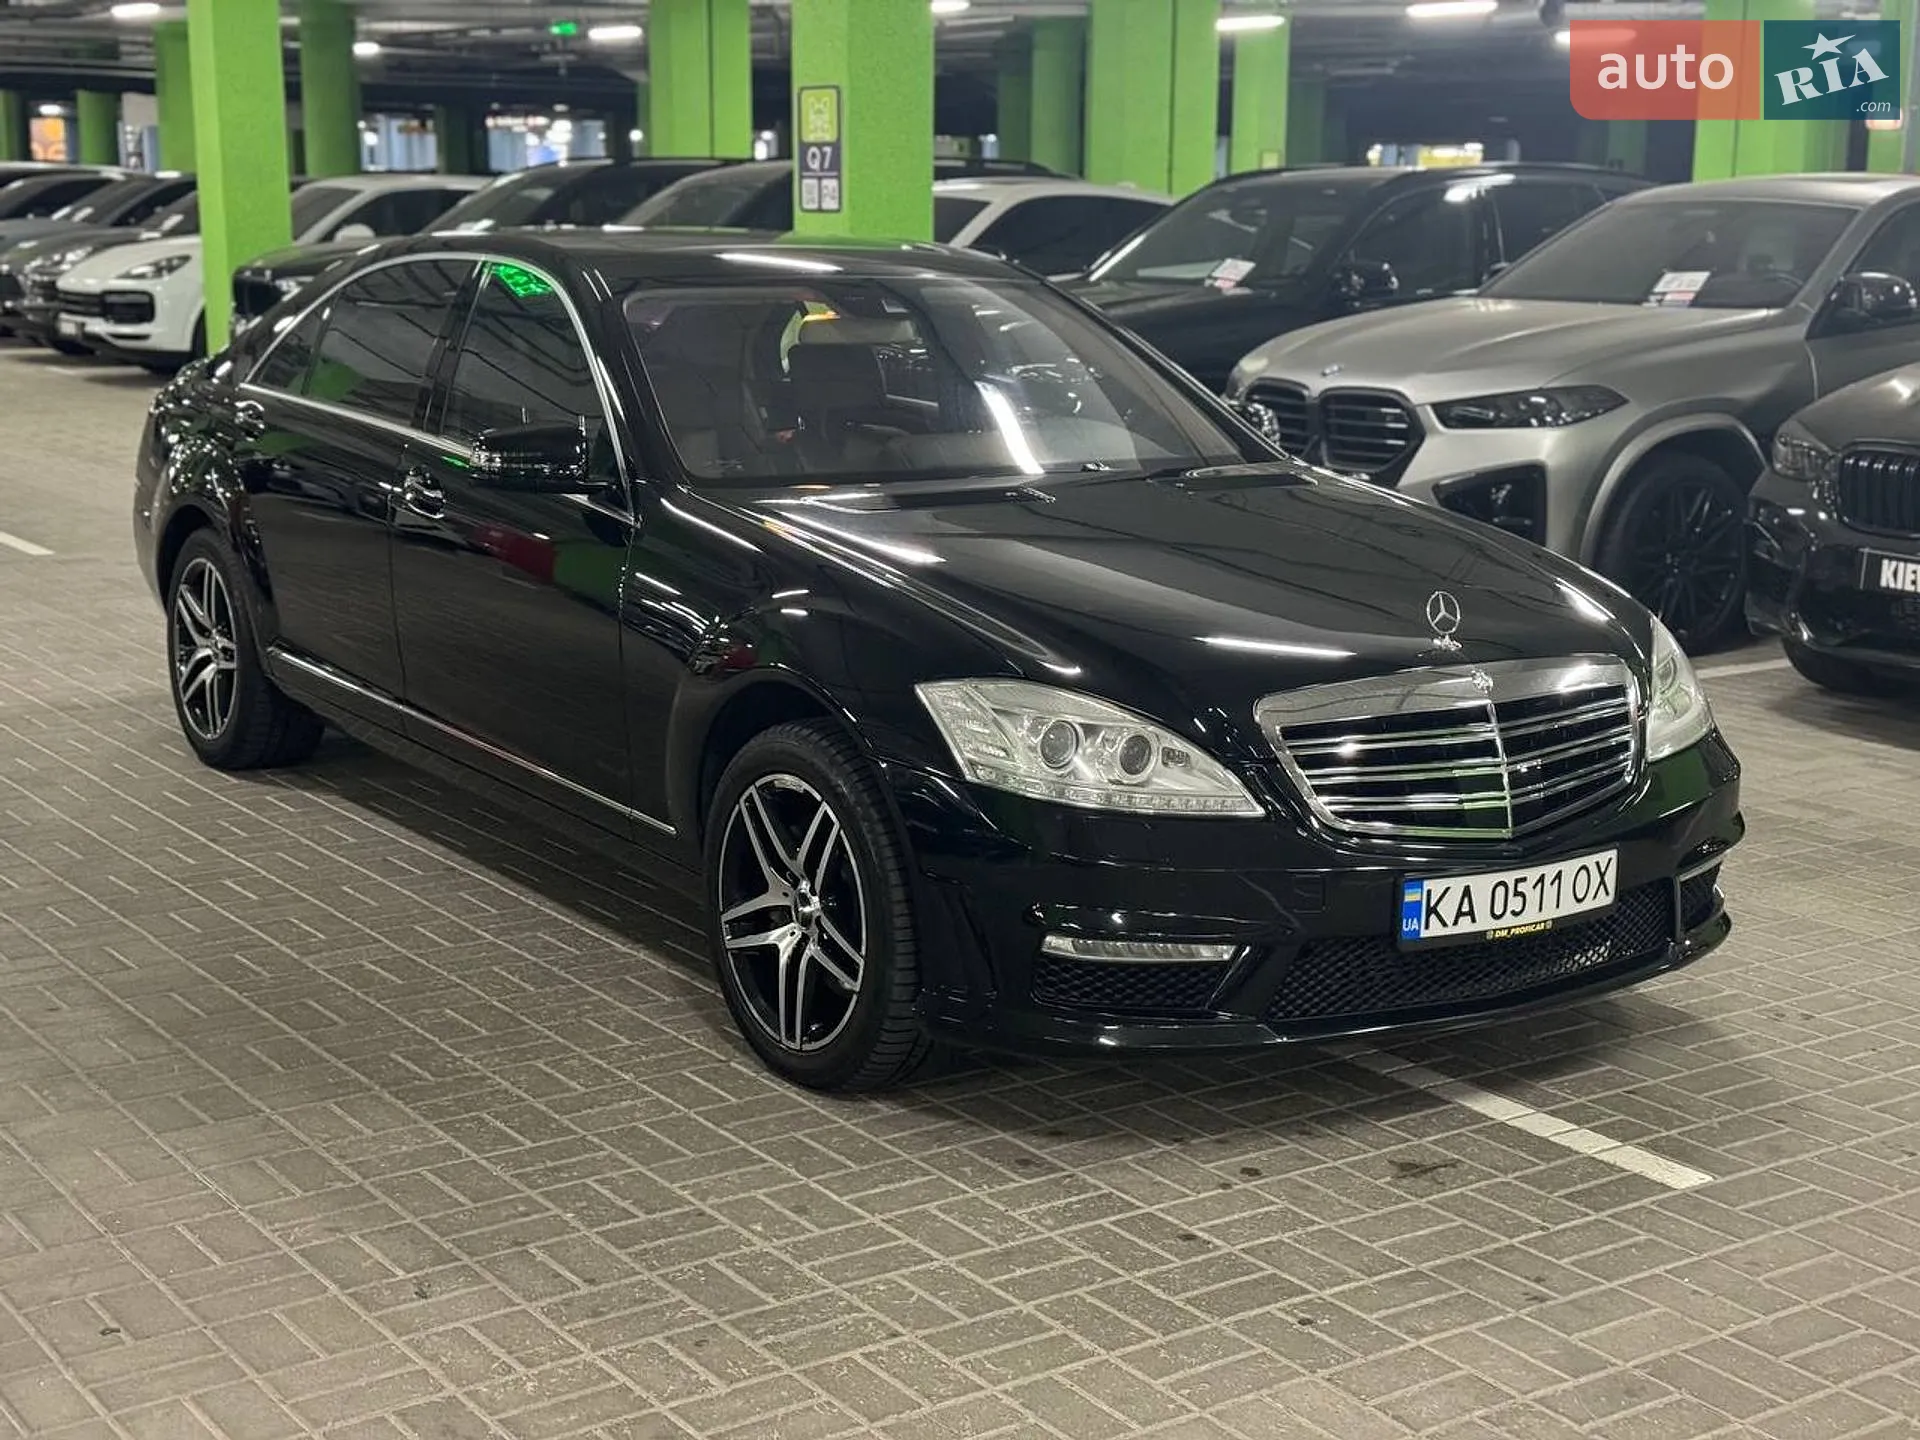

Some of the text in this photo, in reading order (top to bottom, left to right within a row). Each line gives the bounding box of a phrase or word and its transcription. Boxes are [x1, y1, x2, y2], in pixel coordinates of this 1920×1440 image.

[806, 146, 832, 172] Q7
[1880, 558, 1920, 592] KIE
[1423, 857, 1613, 930] KA 0511 OX
[1402, 918, 1419, 931] UA
